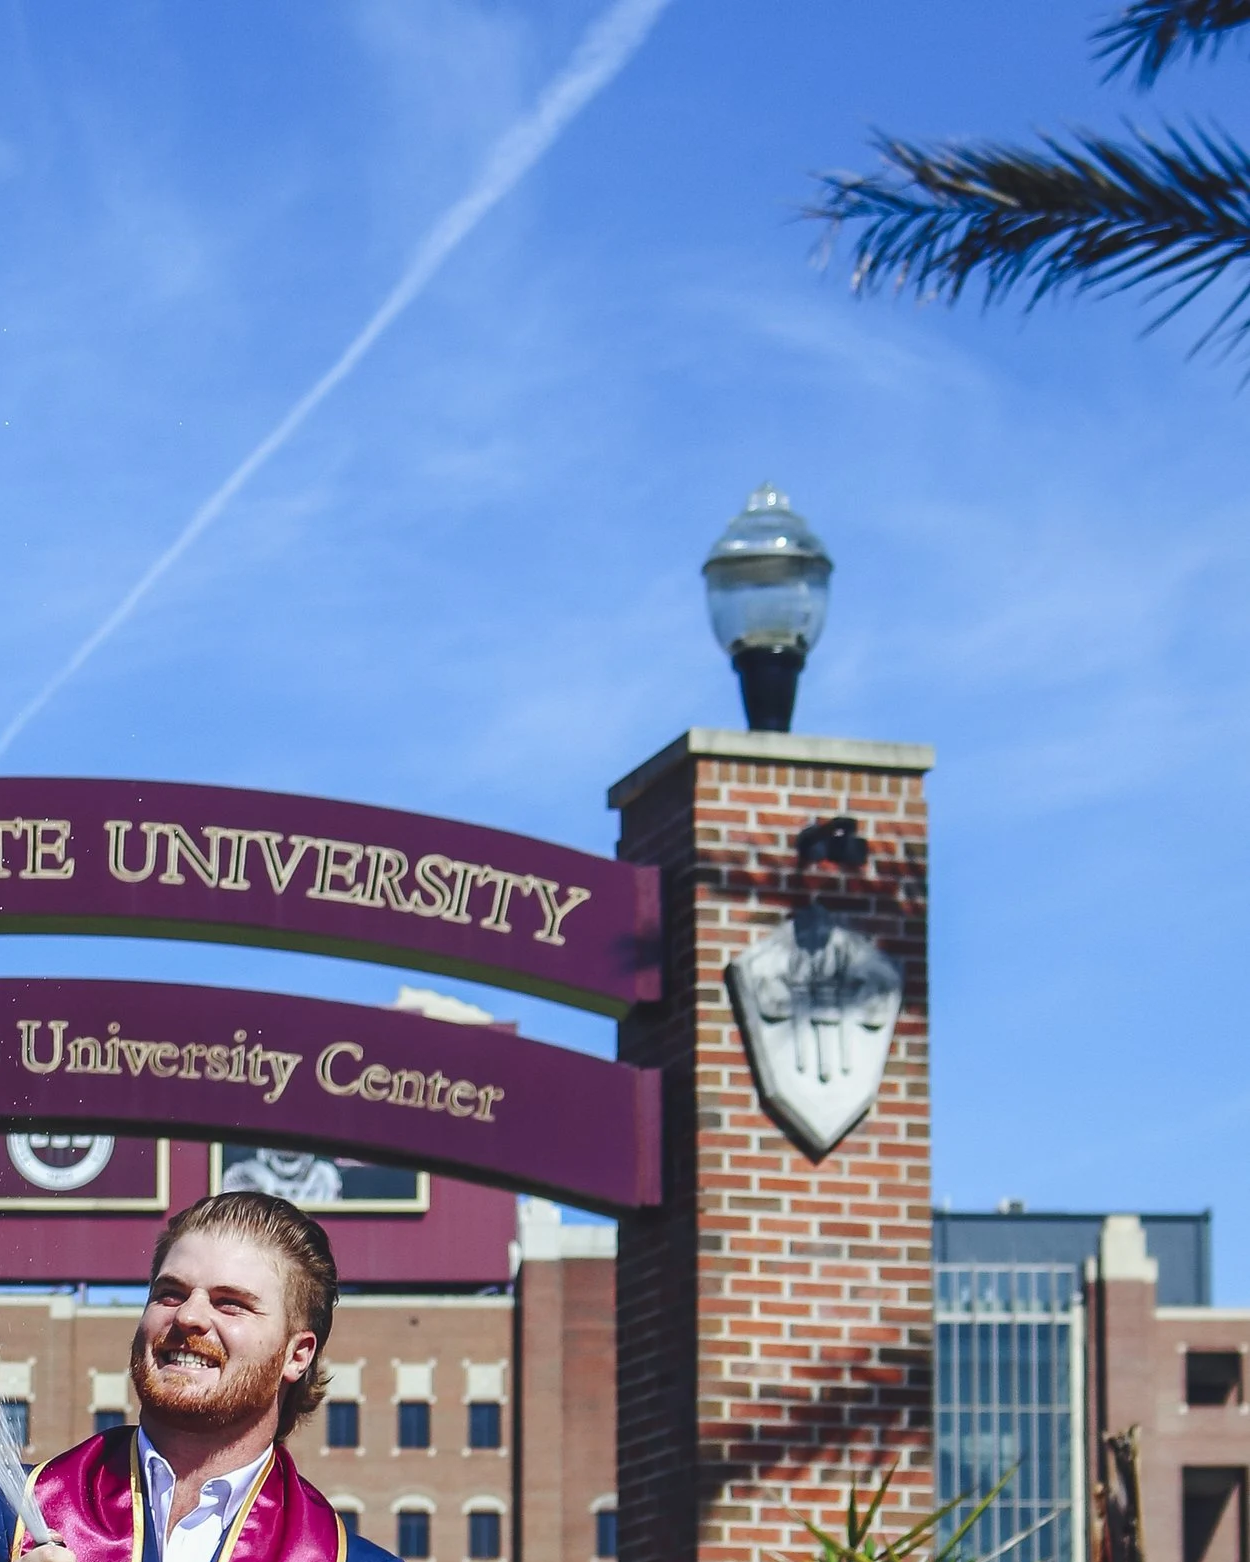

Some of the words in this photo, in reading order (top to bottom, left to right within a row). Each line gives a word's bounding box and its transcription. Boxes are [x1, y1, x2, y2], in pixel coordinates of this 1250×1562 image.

[104, 820, 591, 946] UNIVERSITY
[16, 1019, 303, 1104] University
[314, 1041, 505, 1123] Center
